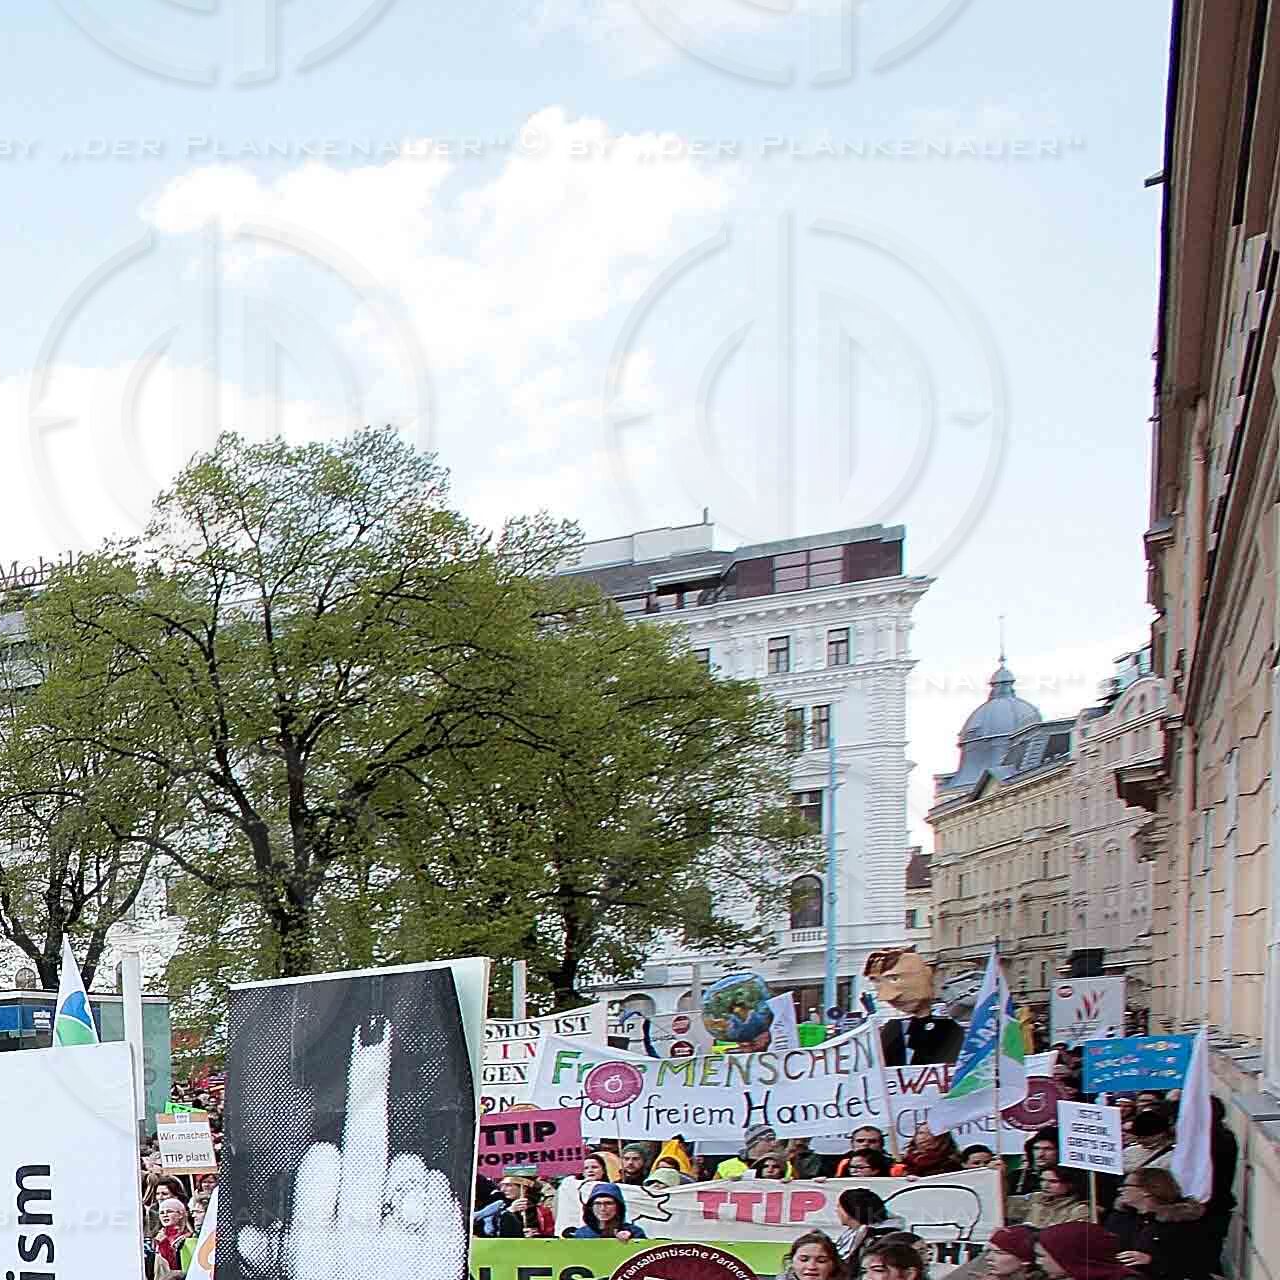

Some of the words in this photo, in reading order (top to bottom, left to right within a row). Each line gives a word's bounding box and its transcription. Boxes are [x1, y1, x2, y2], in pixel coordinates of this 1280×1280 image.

[656, 1036, 873, 1088] MENSCHEN
[644, 1094, 735, 1130] freiem
[742, 1077, 880, 1129] Handel
[164, 1153, 184, 1163] TTIP
[696, 1190, 827, 1225] TTIP
